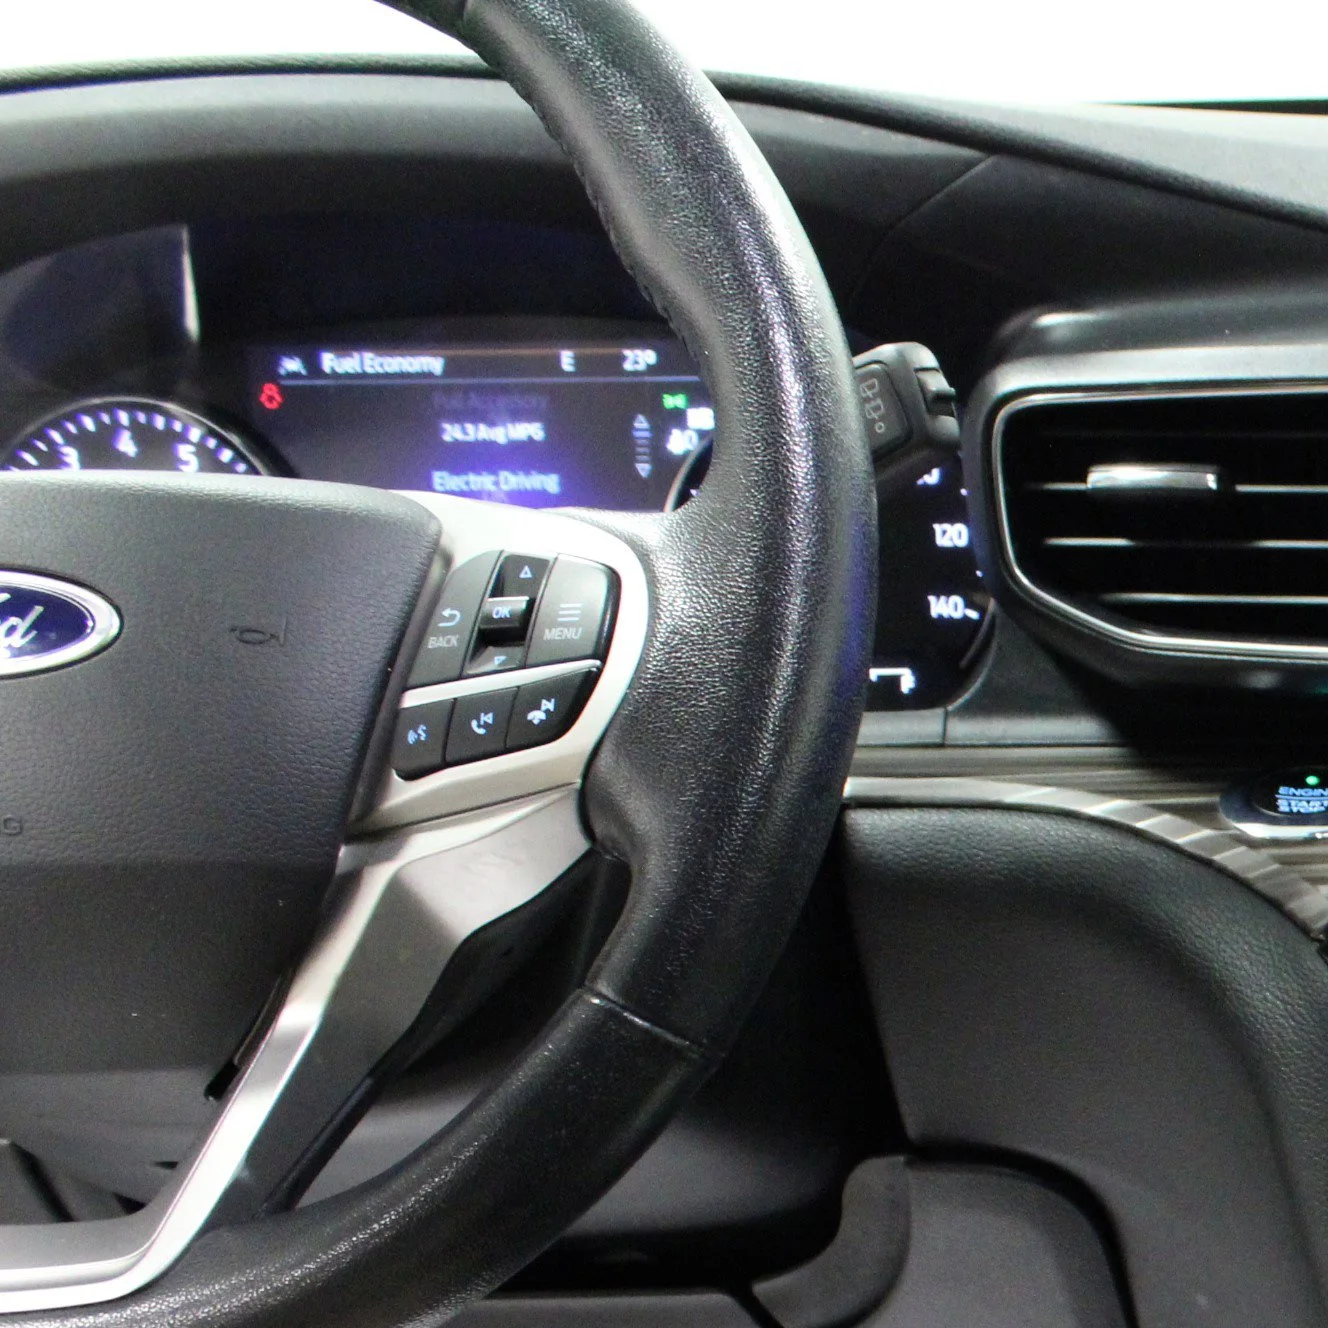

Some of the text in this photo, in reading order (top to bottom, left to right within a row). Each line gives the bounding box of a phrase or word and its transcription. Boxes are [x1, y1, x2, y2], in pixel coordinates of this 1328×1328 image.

[321, 352, 445, 377] Fuel Economy
[114, 427, 137, 458] 4
[175, 442, 200, 473] 5
[431, 470, 561, 494] Electric Driving
[932, 522, 969, 547] 120
[491, 607, 511, 619] OK
[927, 595, 966, 619] 140
[427, 635, 458, 649] BACK
[543, 627, 583, 641] MENU
